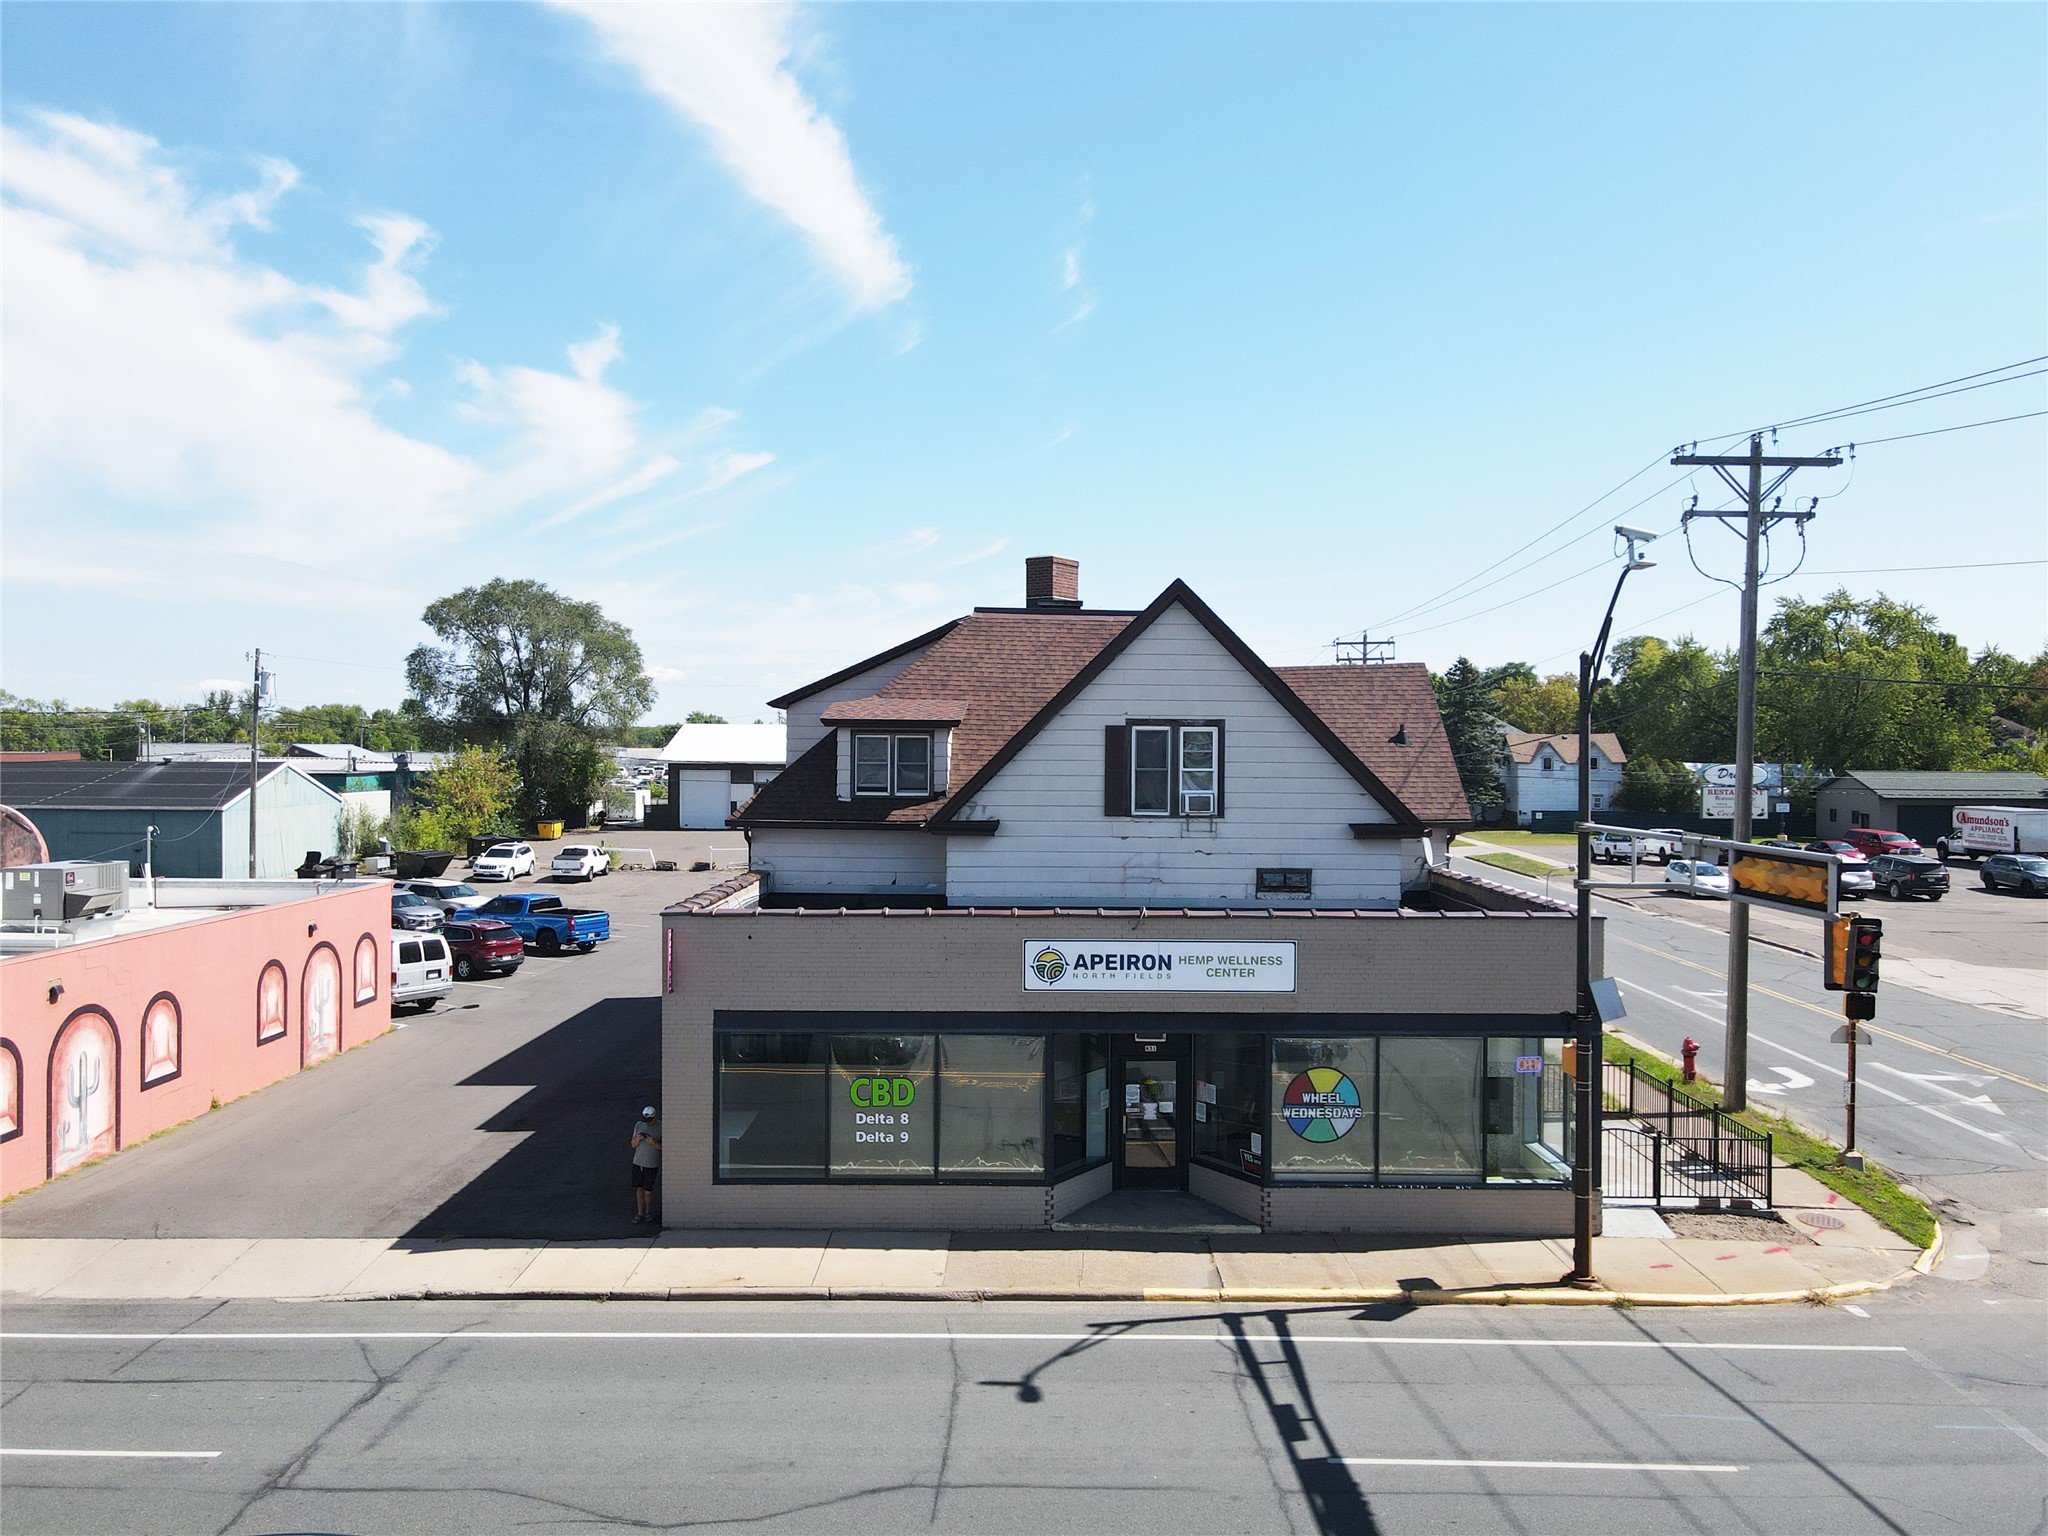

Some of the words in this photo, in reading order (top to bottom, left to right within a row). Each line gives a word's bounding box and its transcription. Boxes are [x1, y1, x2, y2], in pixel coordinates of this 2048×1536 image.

[1707, 788, 1764, 796] RESTANT
[1956, 811, 2010, 827] Amundson's
[1970, 825, 2005, 835] APPLIANCE
[1073, 953, 1172, 971] APEIRON
[1178, 955, 1214, 965] HEMP
[1217, 955, 1283, 966] WELLNESS
[1072, 972, 1116, 980] NORTH
[1125, 972, 1172, 980] FIELDS
[1206, 967, 1256, 978] CENTER
[1519, 1058, 1540, 1071] OPEN
[850, 1077, 915, 1108] CBD
[1302, 1092, 1345, 1104] WHEEL
[855, 1112, 895, 1125] Delta
[900, 1112, 909, 1125] 8
[1282, 1107, 1363, 1119] WEDNESDAYS
[855, 1131, 895, 1143] Delta
[900, 1131, 909, 1143] 9
